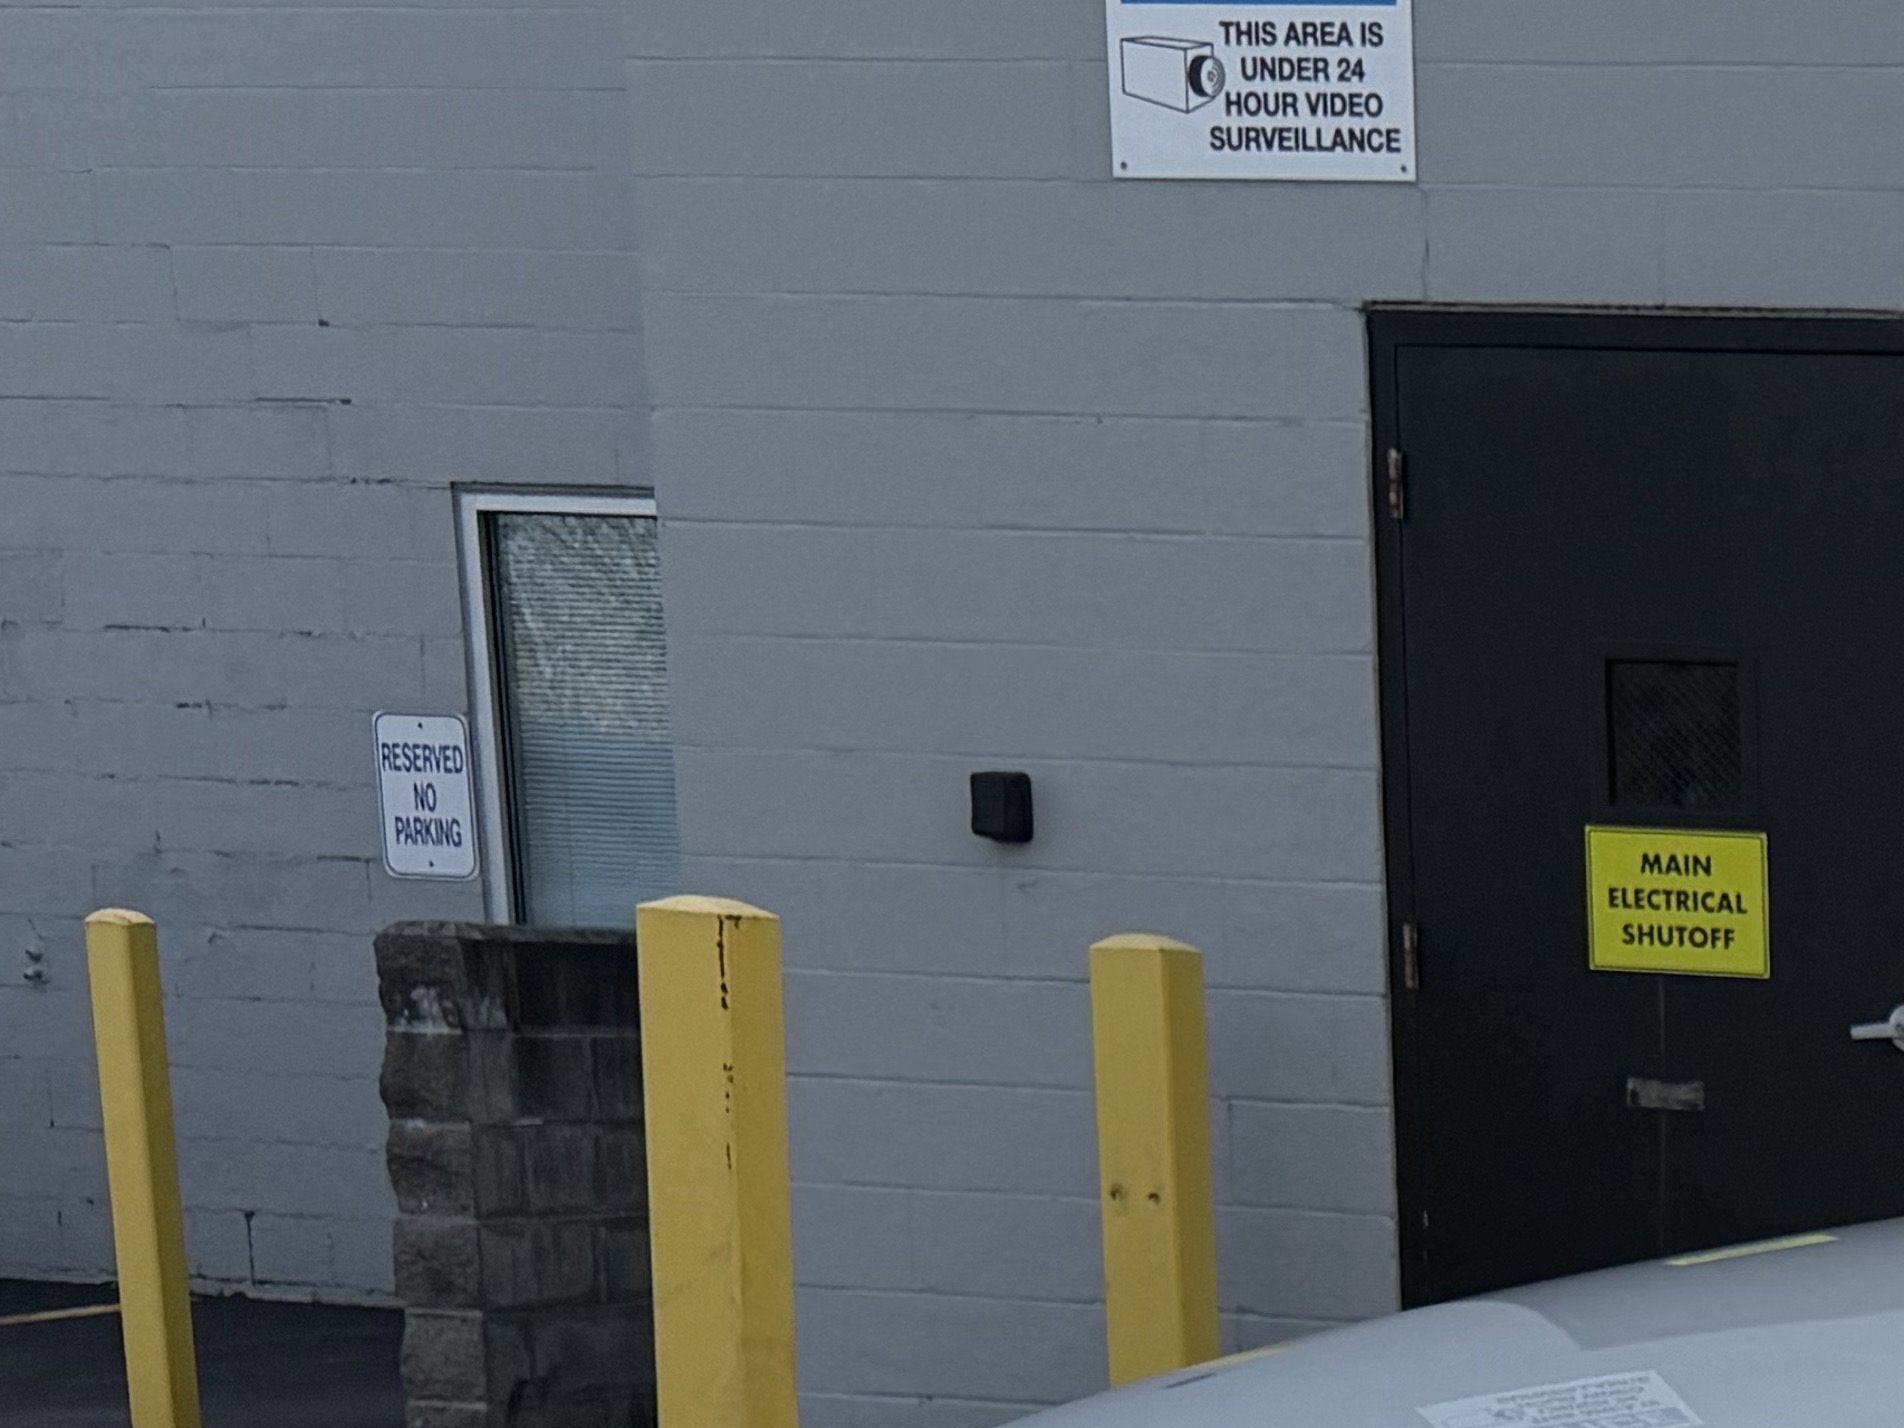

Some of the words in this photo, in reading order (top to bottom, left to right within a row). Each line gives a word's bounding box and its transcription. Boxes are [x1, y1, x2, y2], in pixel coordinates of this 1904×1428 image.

[1219, 21, 1276, 46] THIS
[1284, 22, 1353, 47] AREA
[1361, 22, 1383, 47] IS
[1241, 57, 1329, 82] UNDER
[1337, 58, 1365, 82] 24
[1225, 92, 1298, 117] HOUR
[1306, 93, 1383, 117] VIDEO
[1210, 126, 1401, 153] SURVEILLANCE
[381, 743, 464, 774] RESERVED
[413, 782, 437, 812] NO
[394, 816, 462, 847] PARKING
[1640, 853, 1712, 877] MAIN
[1608, 887, 1748, 914] ELECTRICAL
[1622, 923, 1735, 950] SHUTOFF
